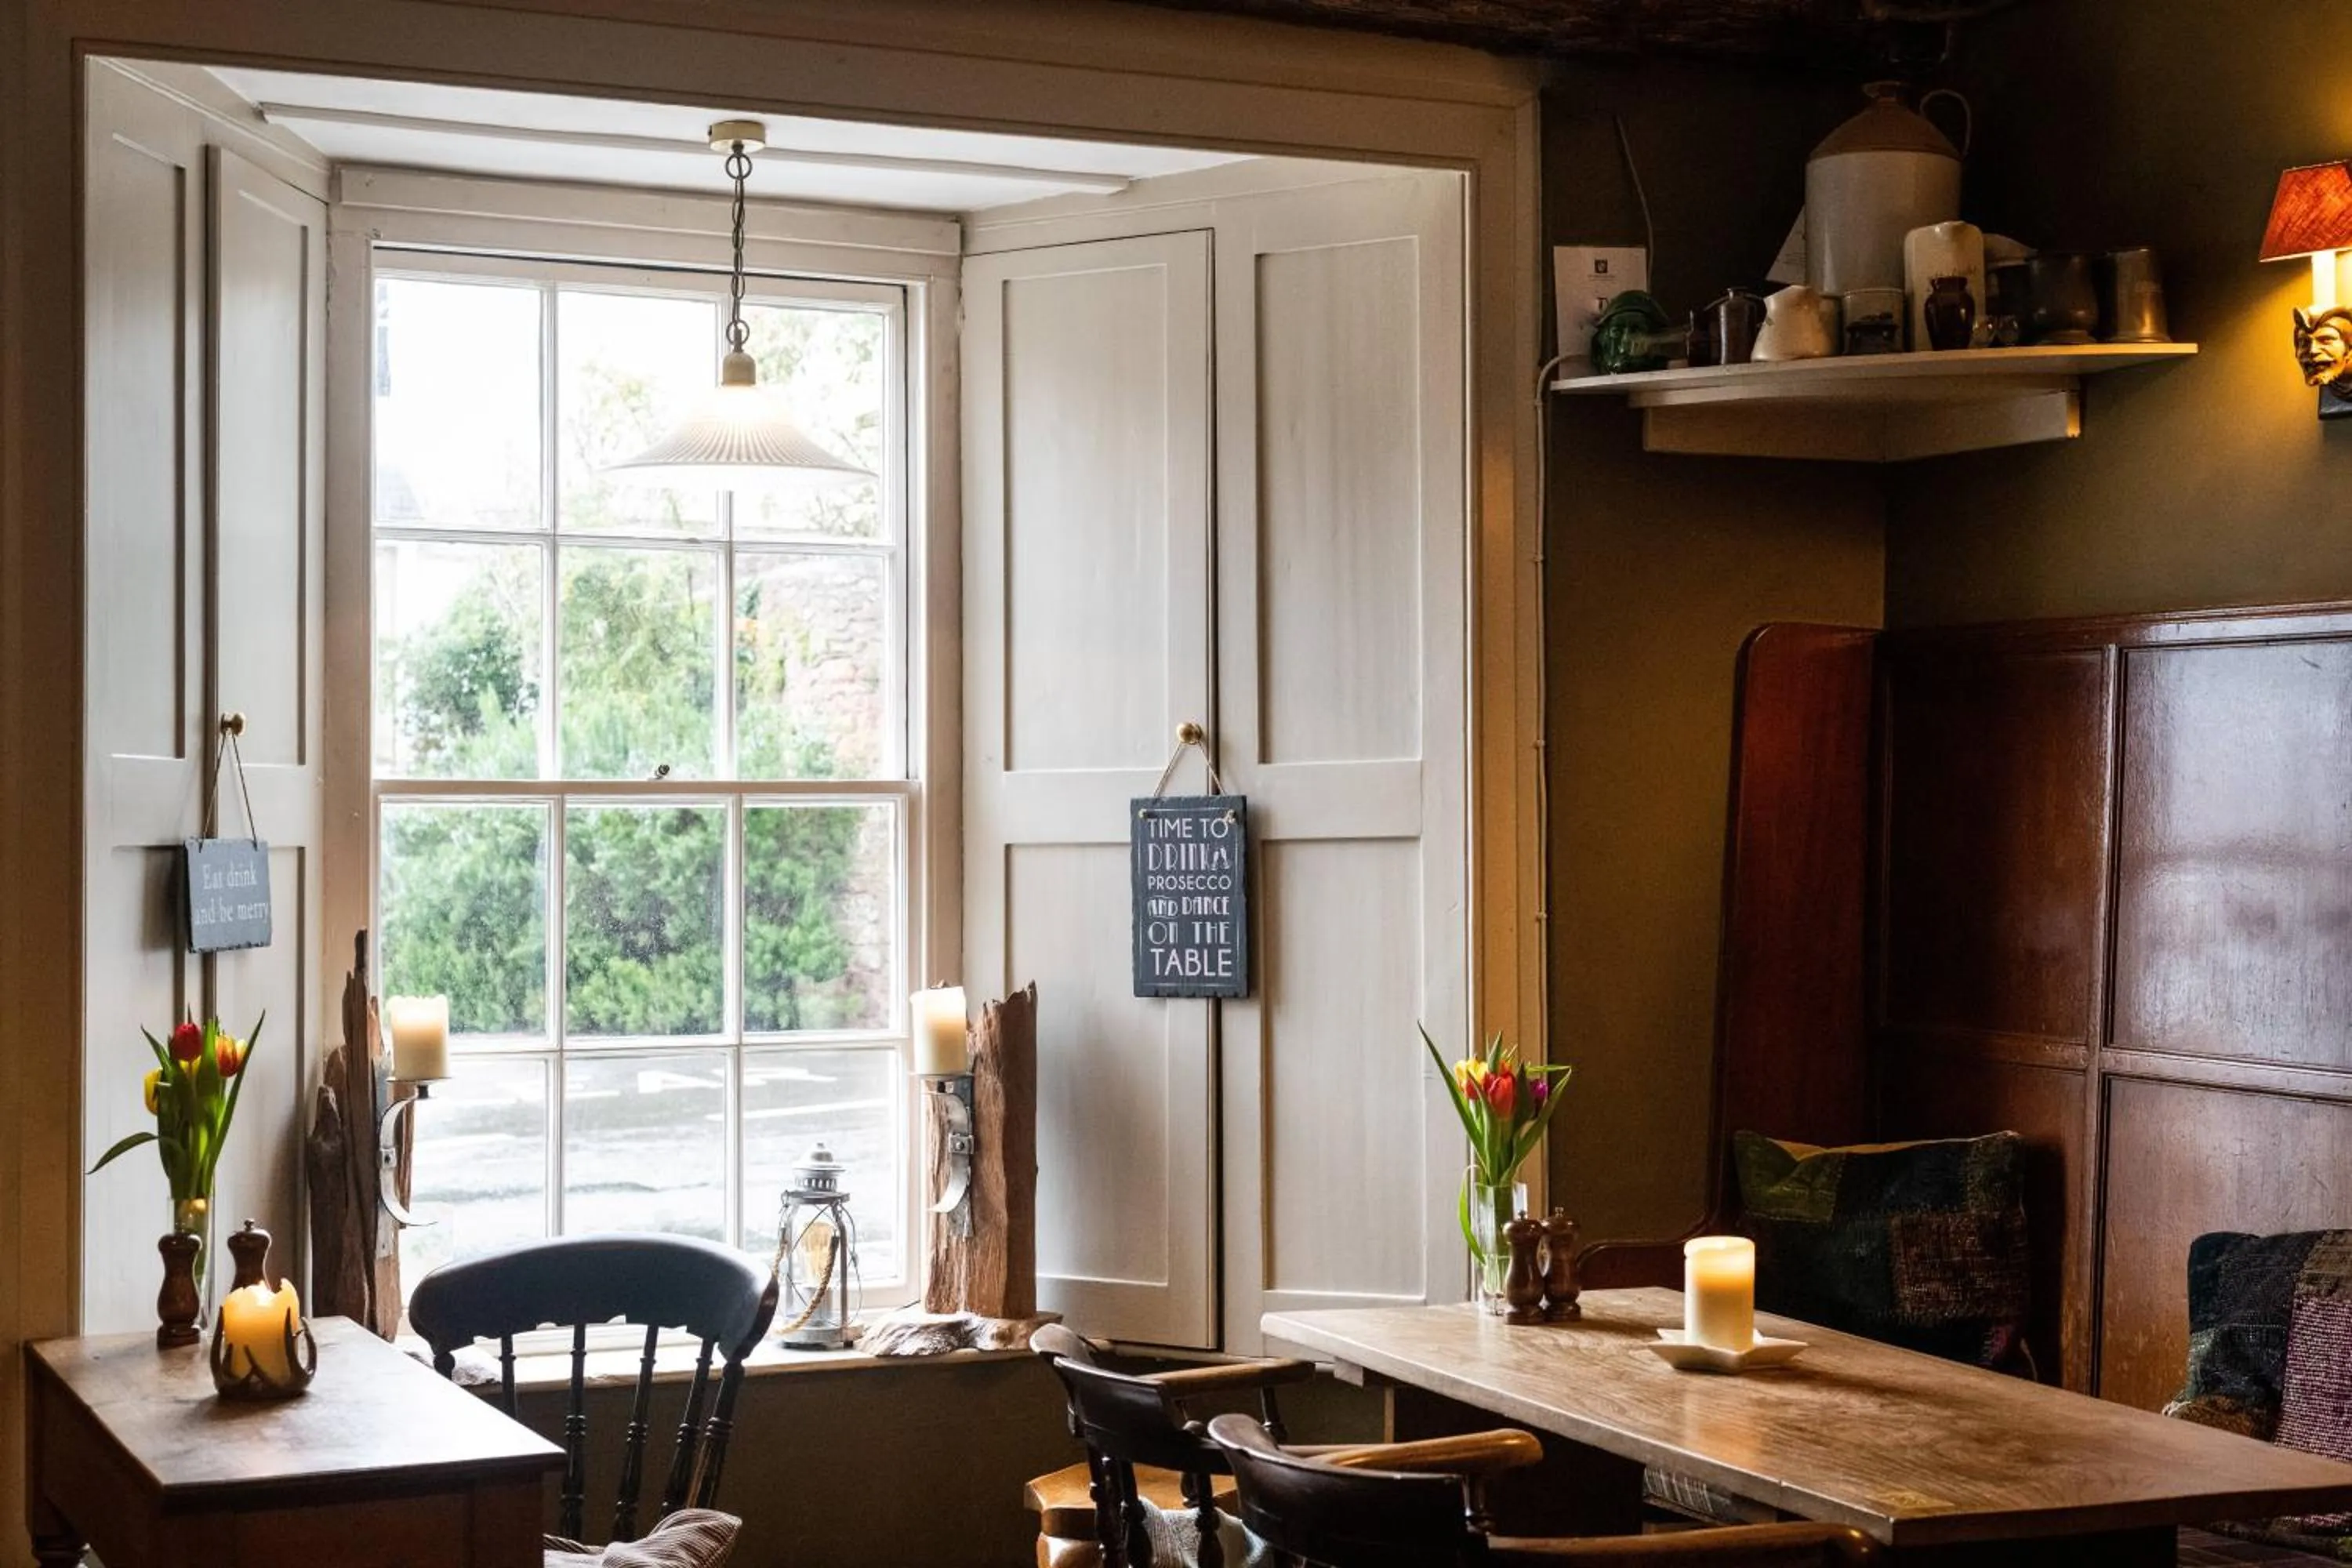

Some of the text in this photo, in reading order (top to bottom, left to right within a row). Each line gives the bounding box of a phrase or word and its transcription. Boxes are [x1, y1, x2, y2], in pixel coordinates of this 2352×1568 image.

[1147, 818, 1229, 838] TIME TO
[1148, 843, 1210, 871] DRINK
[202, 861, 257, 890] Eat drink
[1147, 875, 1232, 891] PROSECCO
[194, 896, 268, 925] and be merry
[1147, 896, 1229, 916] AND DANCE
[1147, 921, 1230, 944] ON THE
[1149, 949, 1232, 977] TABLE
